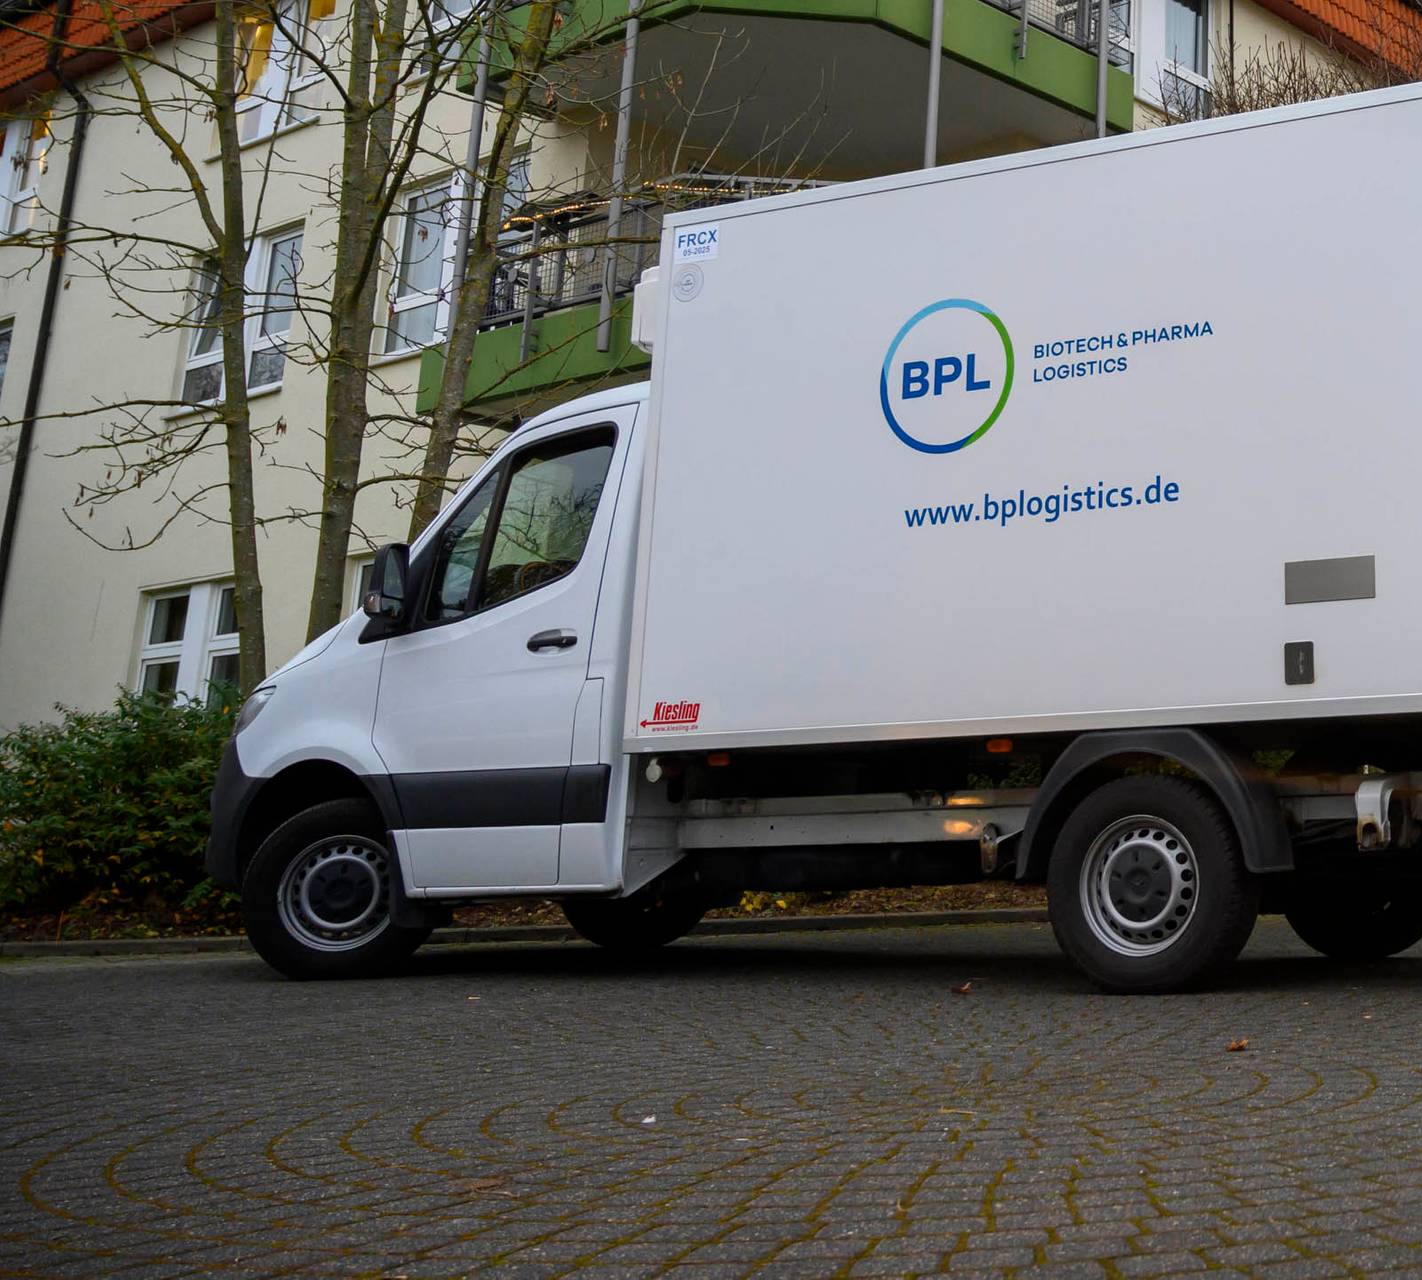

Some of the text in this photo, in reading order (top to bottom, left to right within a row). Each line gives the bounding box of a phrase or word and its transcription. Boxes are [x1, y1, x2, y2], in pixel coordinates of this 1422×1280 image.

[678, 229, 717, 248] FRCX
[683, 245, 711, 257] 05-2025
[1034, 321, 1214, 359] BIOTECH & PHARMA
[901, 353, 991, 400] BPL
[1033, 357, 1128, 383] LOGISTICS
[904, 475, 1180, 528] www.bplogistics.de
[653, 700, 701, 721] Kiesling
